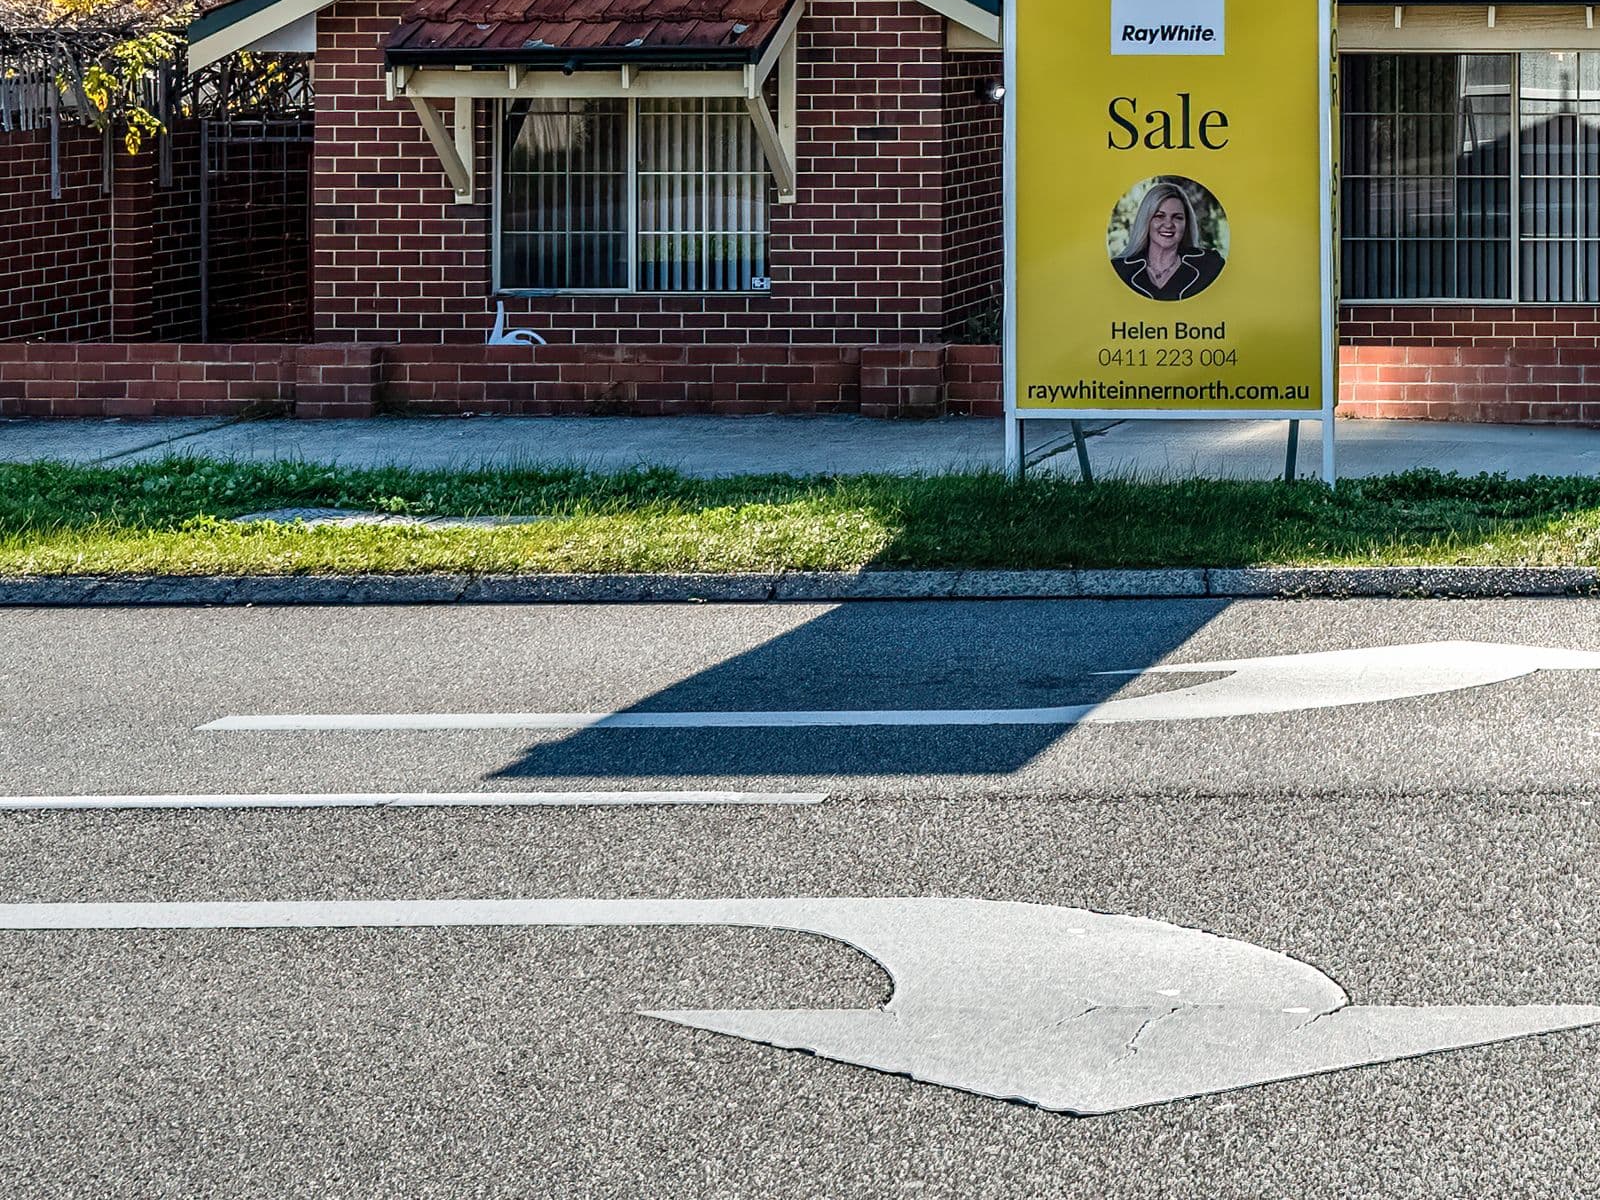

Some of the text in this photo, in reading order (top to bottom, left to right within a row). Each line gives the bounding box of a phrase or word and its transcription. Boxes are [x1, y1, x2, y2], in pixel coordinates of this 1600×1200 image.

[1108, 92, 1229, 150] Sale
[1111, 321, 1226, 340] Helen Bond
[1098, 348, 1238, 367] 0411 223 004
[1027, 380, 1310, 402] raywhiteinnernorth.com.au
